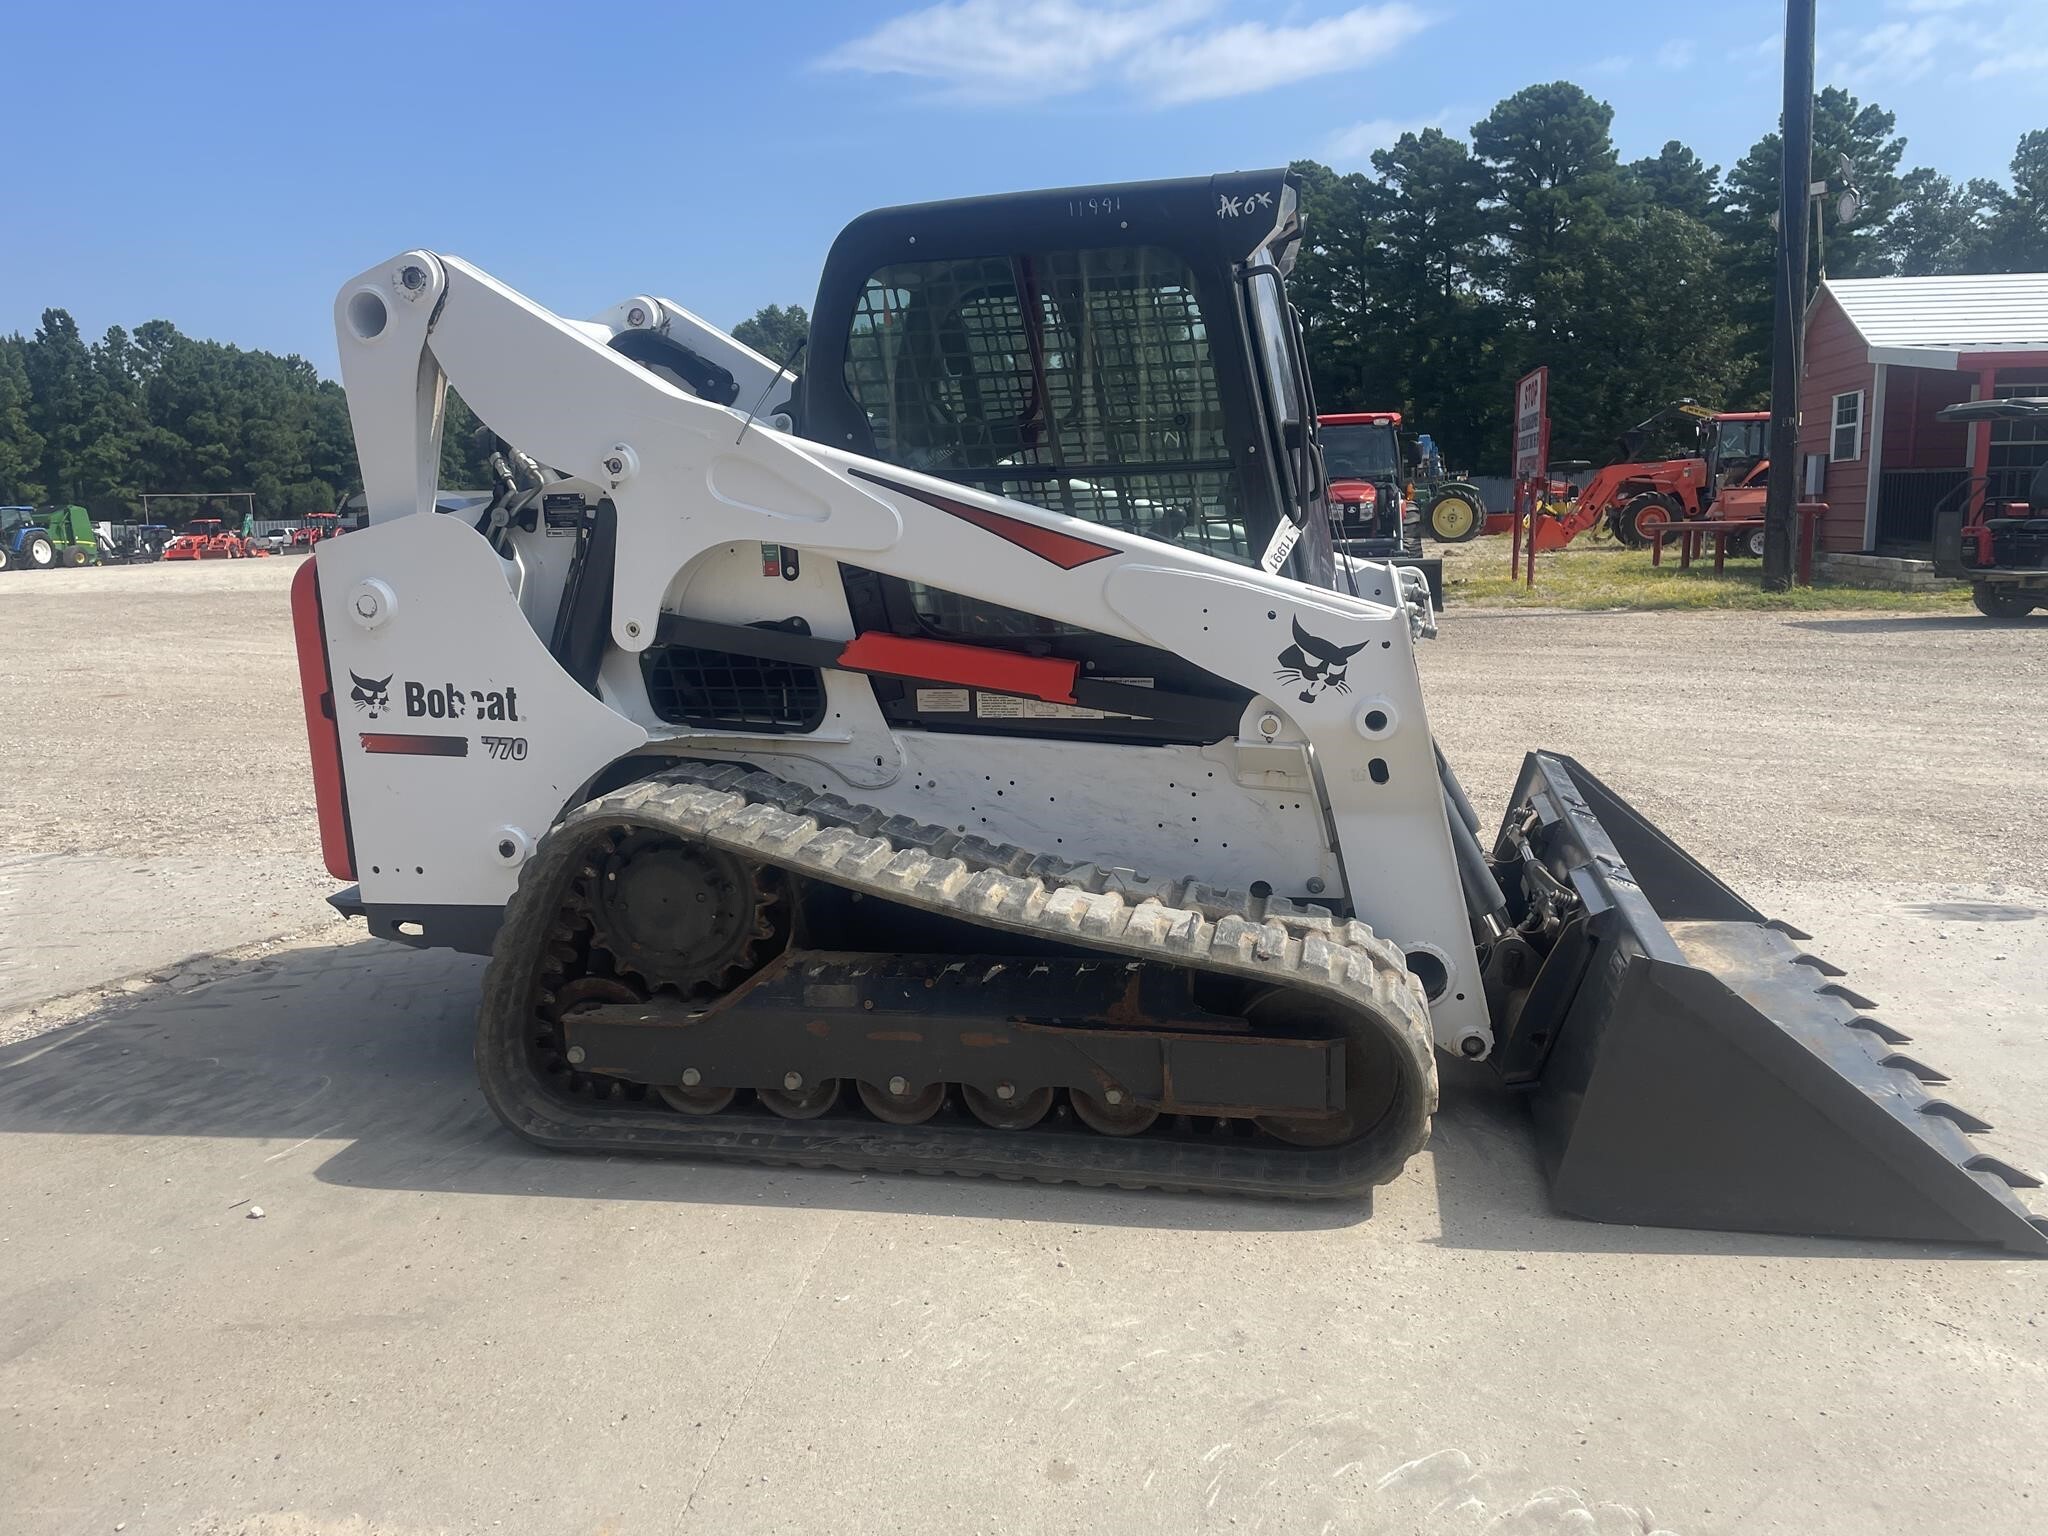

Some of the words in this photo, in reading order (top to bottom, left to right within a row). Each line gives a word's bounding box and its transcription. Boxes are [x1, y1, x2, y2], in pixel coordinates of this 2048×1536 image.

[1069, 197, 1121, 216] 11991
[1524, 379, 1538, 410] STOP
[1269, 535, 1294, 569] 11991
